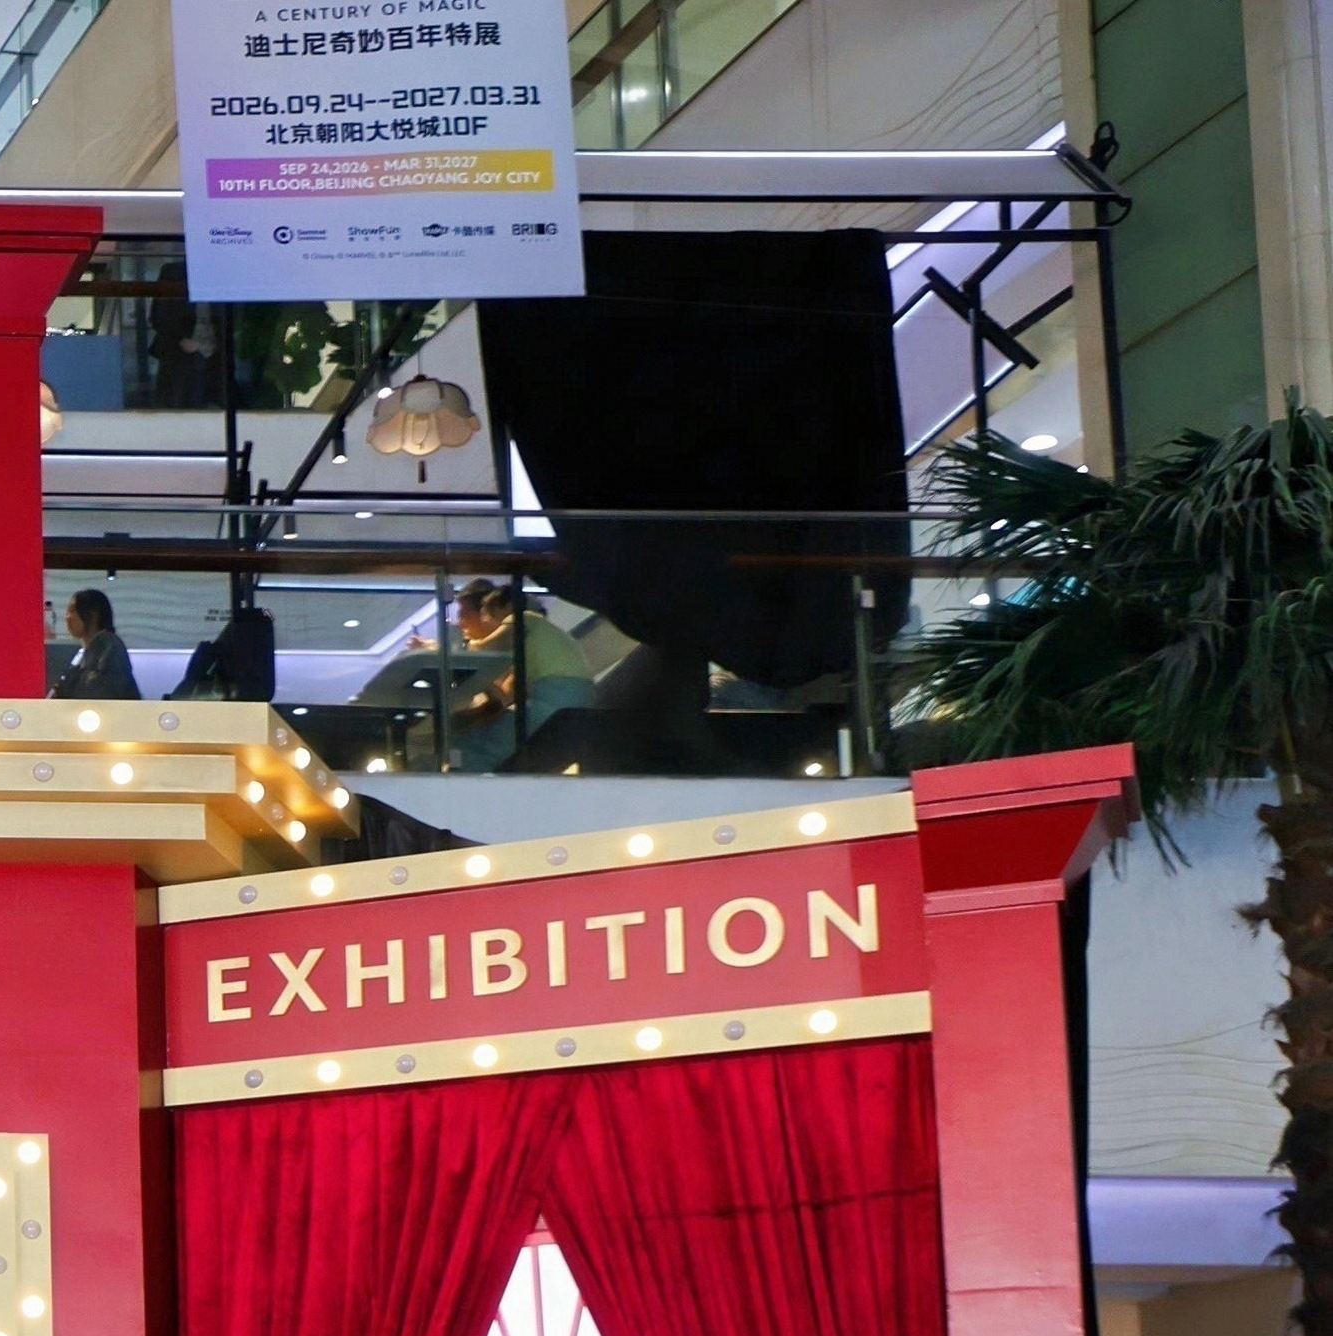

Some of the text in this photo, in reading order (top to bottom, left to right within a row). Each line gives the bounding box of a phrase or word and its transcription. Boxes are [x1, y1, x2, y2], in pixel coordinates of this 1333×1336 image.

[255, 0, 487, 22] A CENTURY OF MAGIC
[245, 22, 501, 57] 迪士尼奇妙百年特展
[266, 116, 487, 144] 北京朝阳大悦城10F
[279, 163, 307, 175] SEP
[311, 161, 369, 176] 24,2026
[384, 157, 420, 172] MAR
[219, 179, 256, 192] 10TH
[379, 171, 468, 188] CHAOYANG
[473, 171, 501, 184] JOY
[506, 171, 540, 184] CITY
[204, 883, 881, 1024] EXHIBITION
